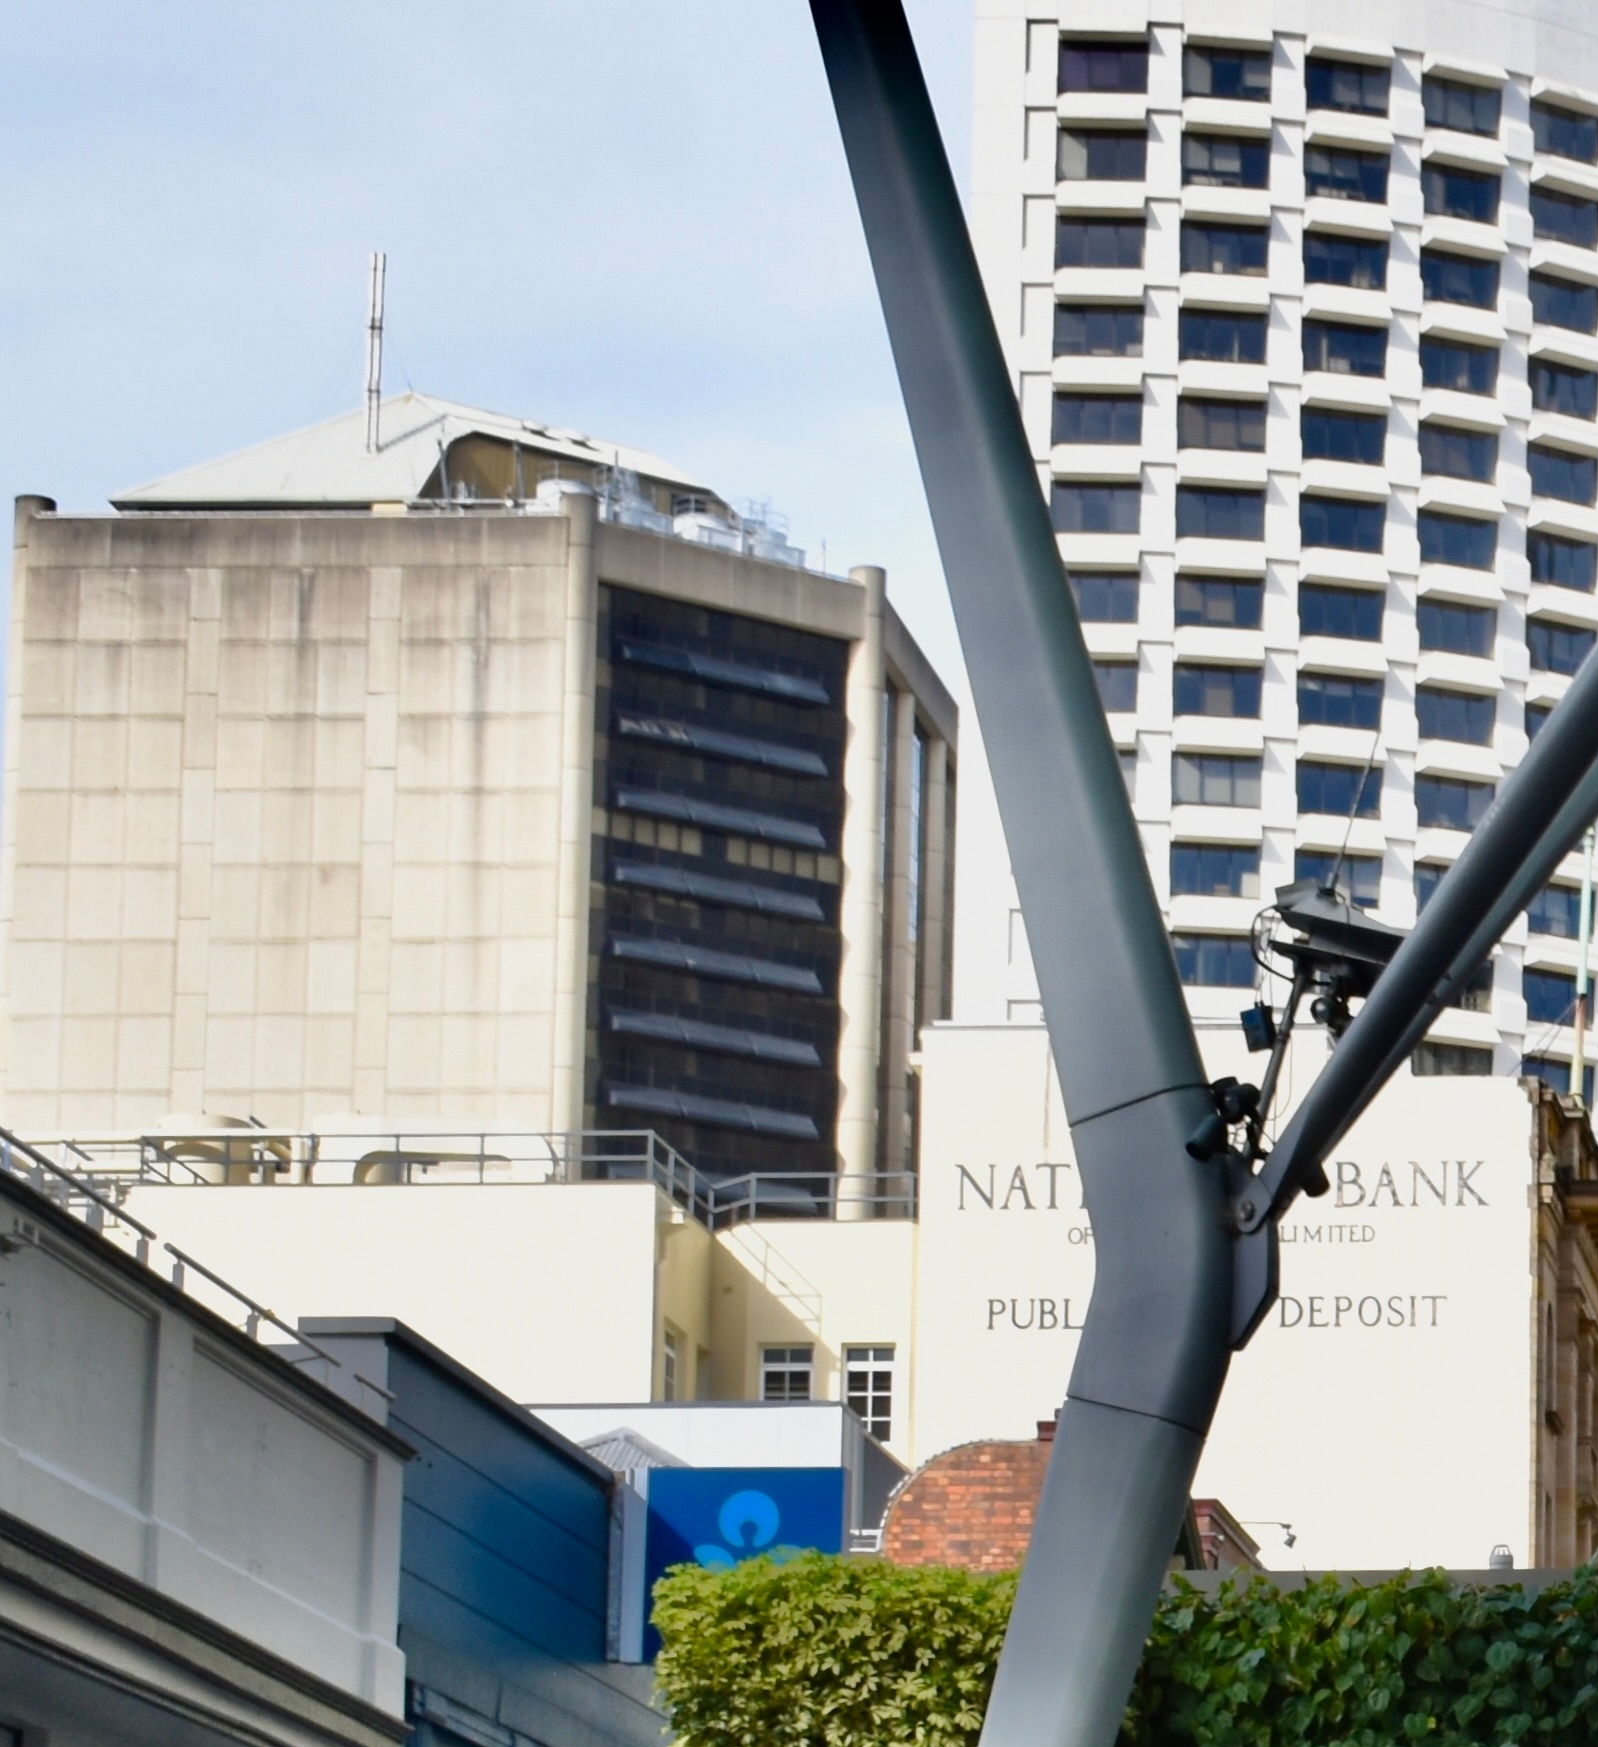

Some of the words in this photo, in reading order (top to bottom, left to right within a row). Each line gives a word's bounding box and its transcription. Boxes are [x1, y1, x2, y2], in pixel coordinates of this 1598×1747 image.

[955, 1163, 1088, 1210] NAT
[1334, 1160, 1489, 1209] BANK
[1279, 1224, 1376, 1243] LIMITED
[987, 1298, 1085, 1330] PUBL
[1279, 1294, 1447, 1329] DEPOSIT
